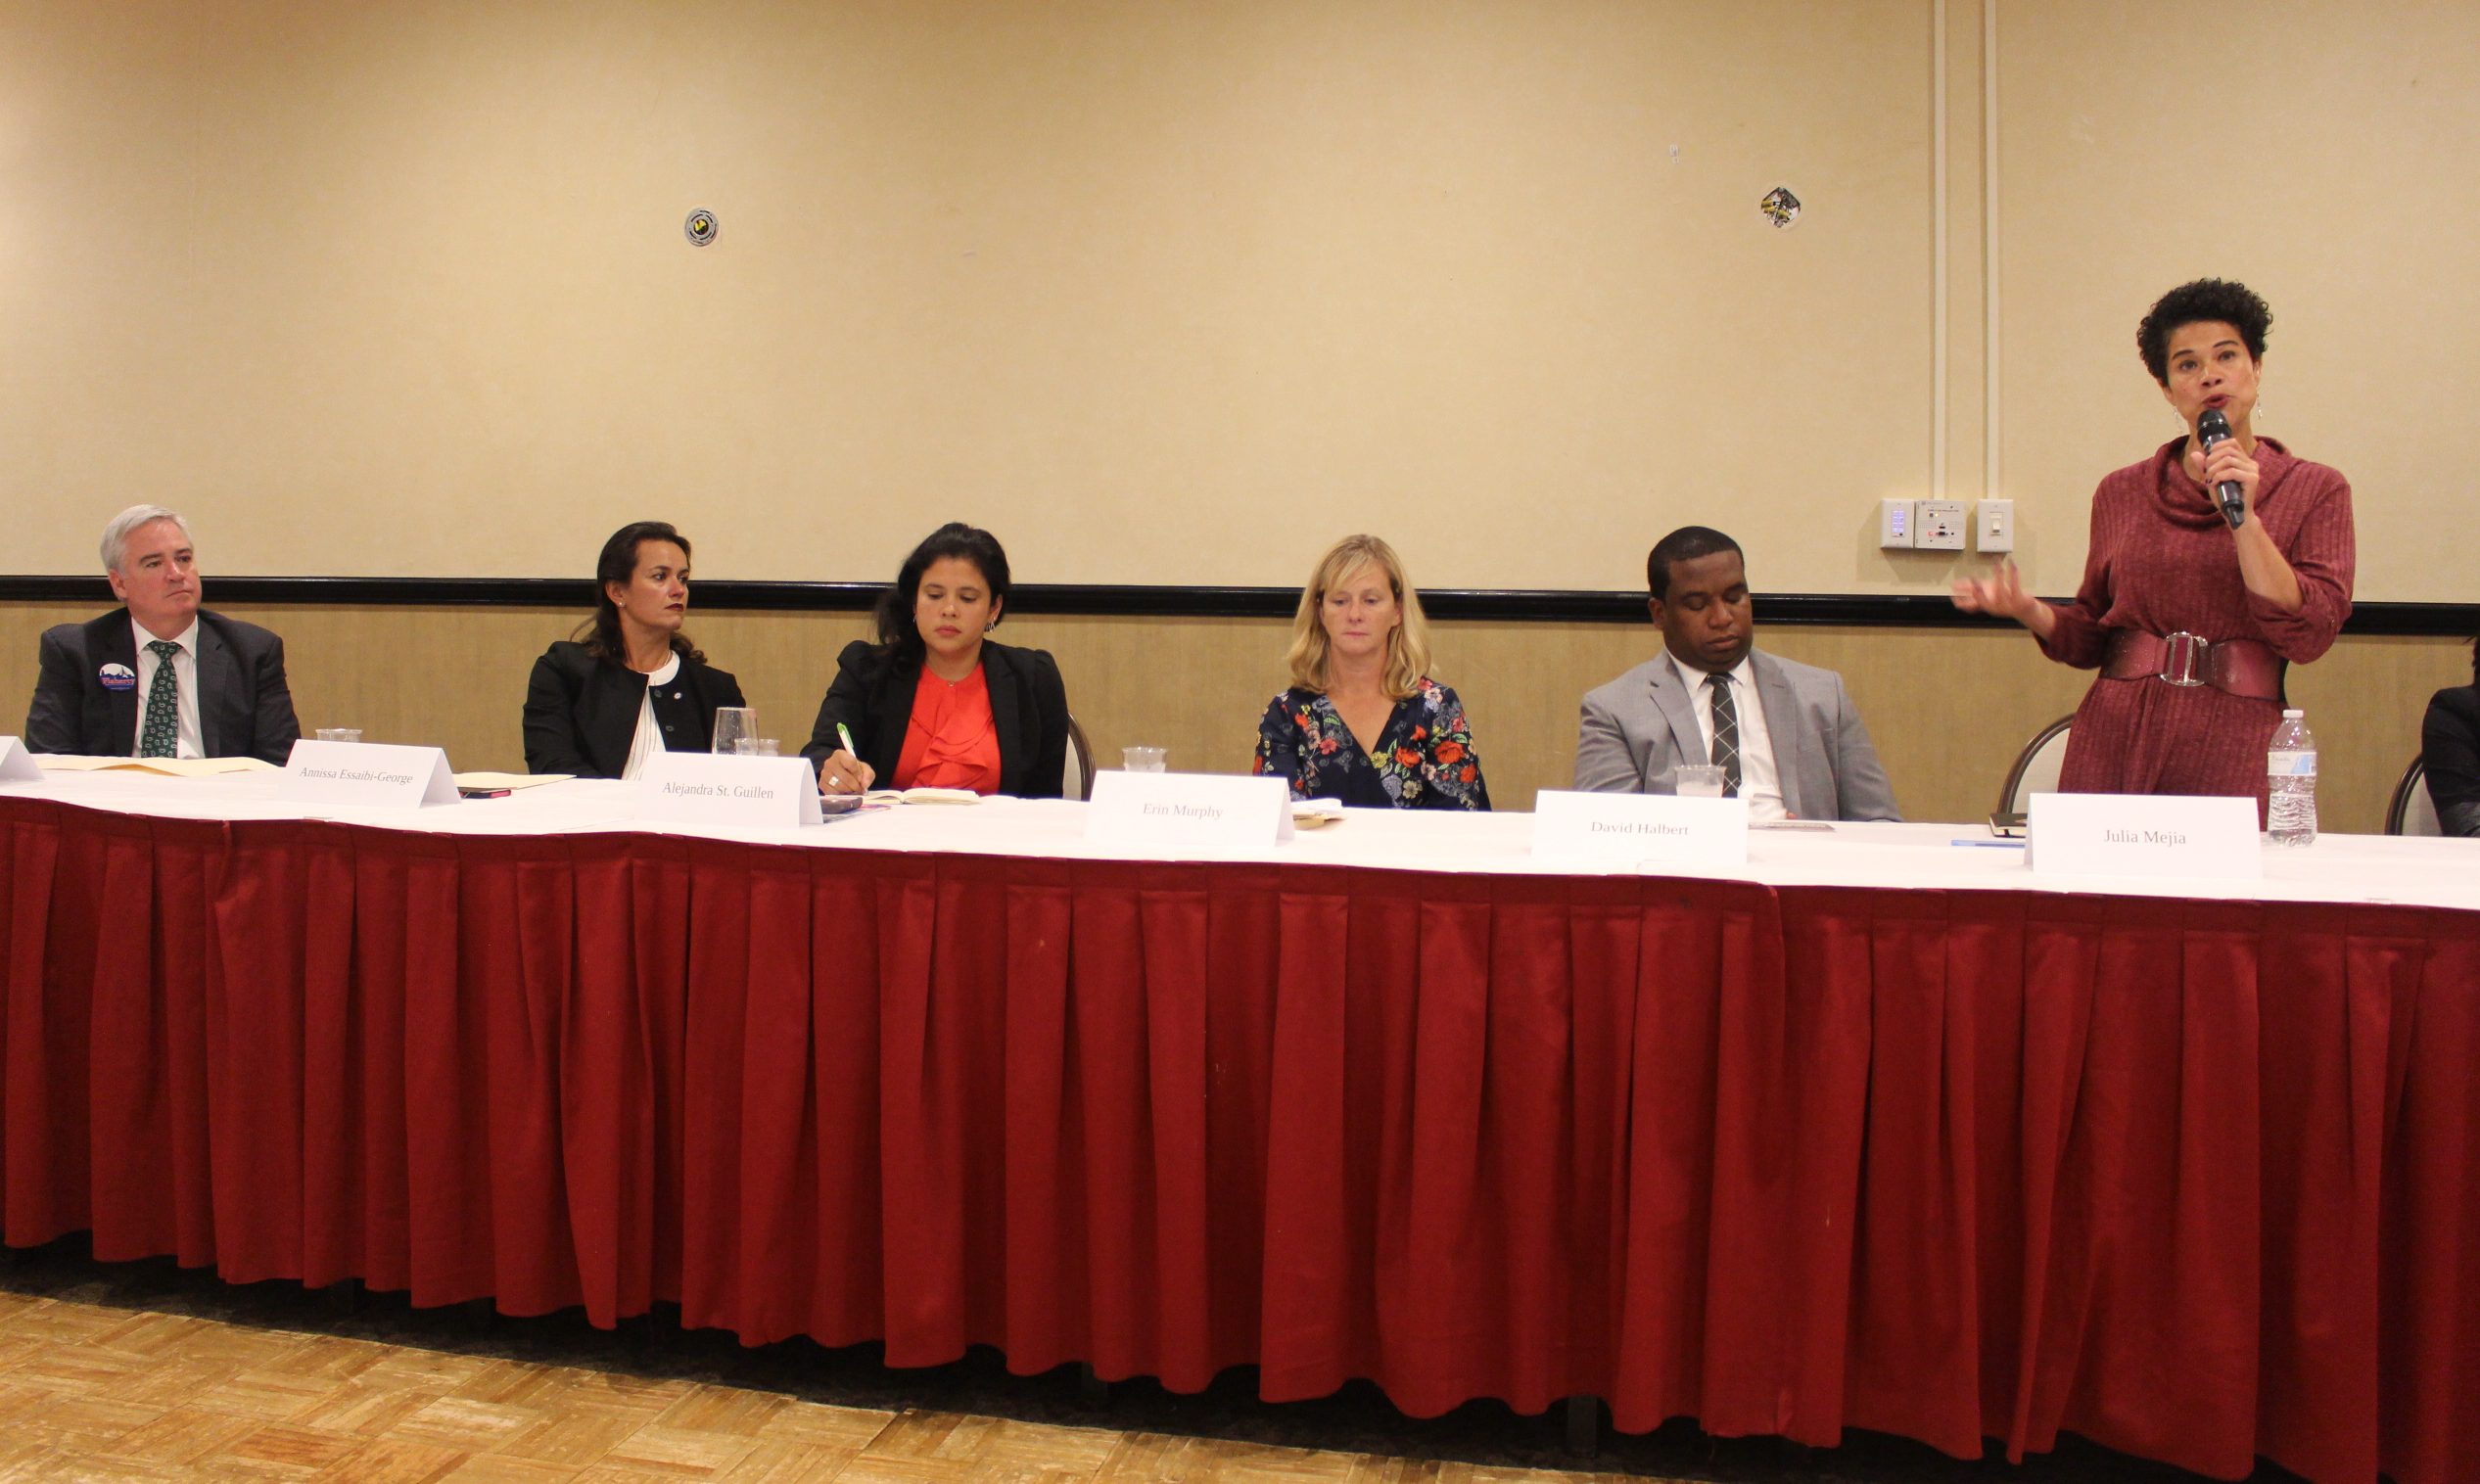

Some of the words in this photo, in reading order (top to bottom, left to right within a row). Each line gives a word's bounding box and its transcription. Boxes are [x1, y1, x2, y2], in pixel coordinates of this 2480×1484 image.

[299, 766, 338, 779] Annissa
[339, 768, 413, 786] Essaibi-George
[662, 782, 714, 797] Alejandra
[716, 784, 730, 798] St.
[733, 785, 775, 799] Guillen
[1143, 803, 1169, 815] Erin
[1173, 805, 1224, 821] Murphy
[1590, 821, 1634, 834] David
[1637, 823, 1689, 835] Halbert
[2104, 829, 2138, 843] Julia
[2143, 830, 2186, 847] Mejia
